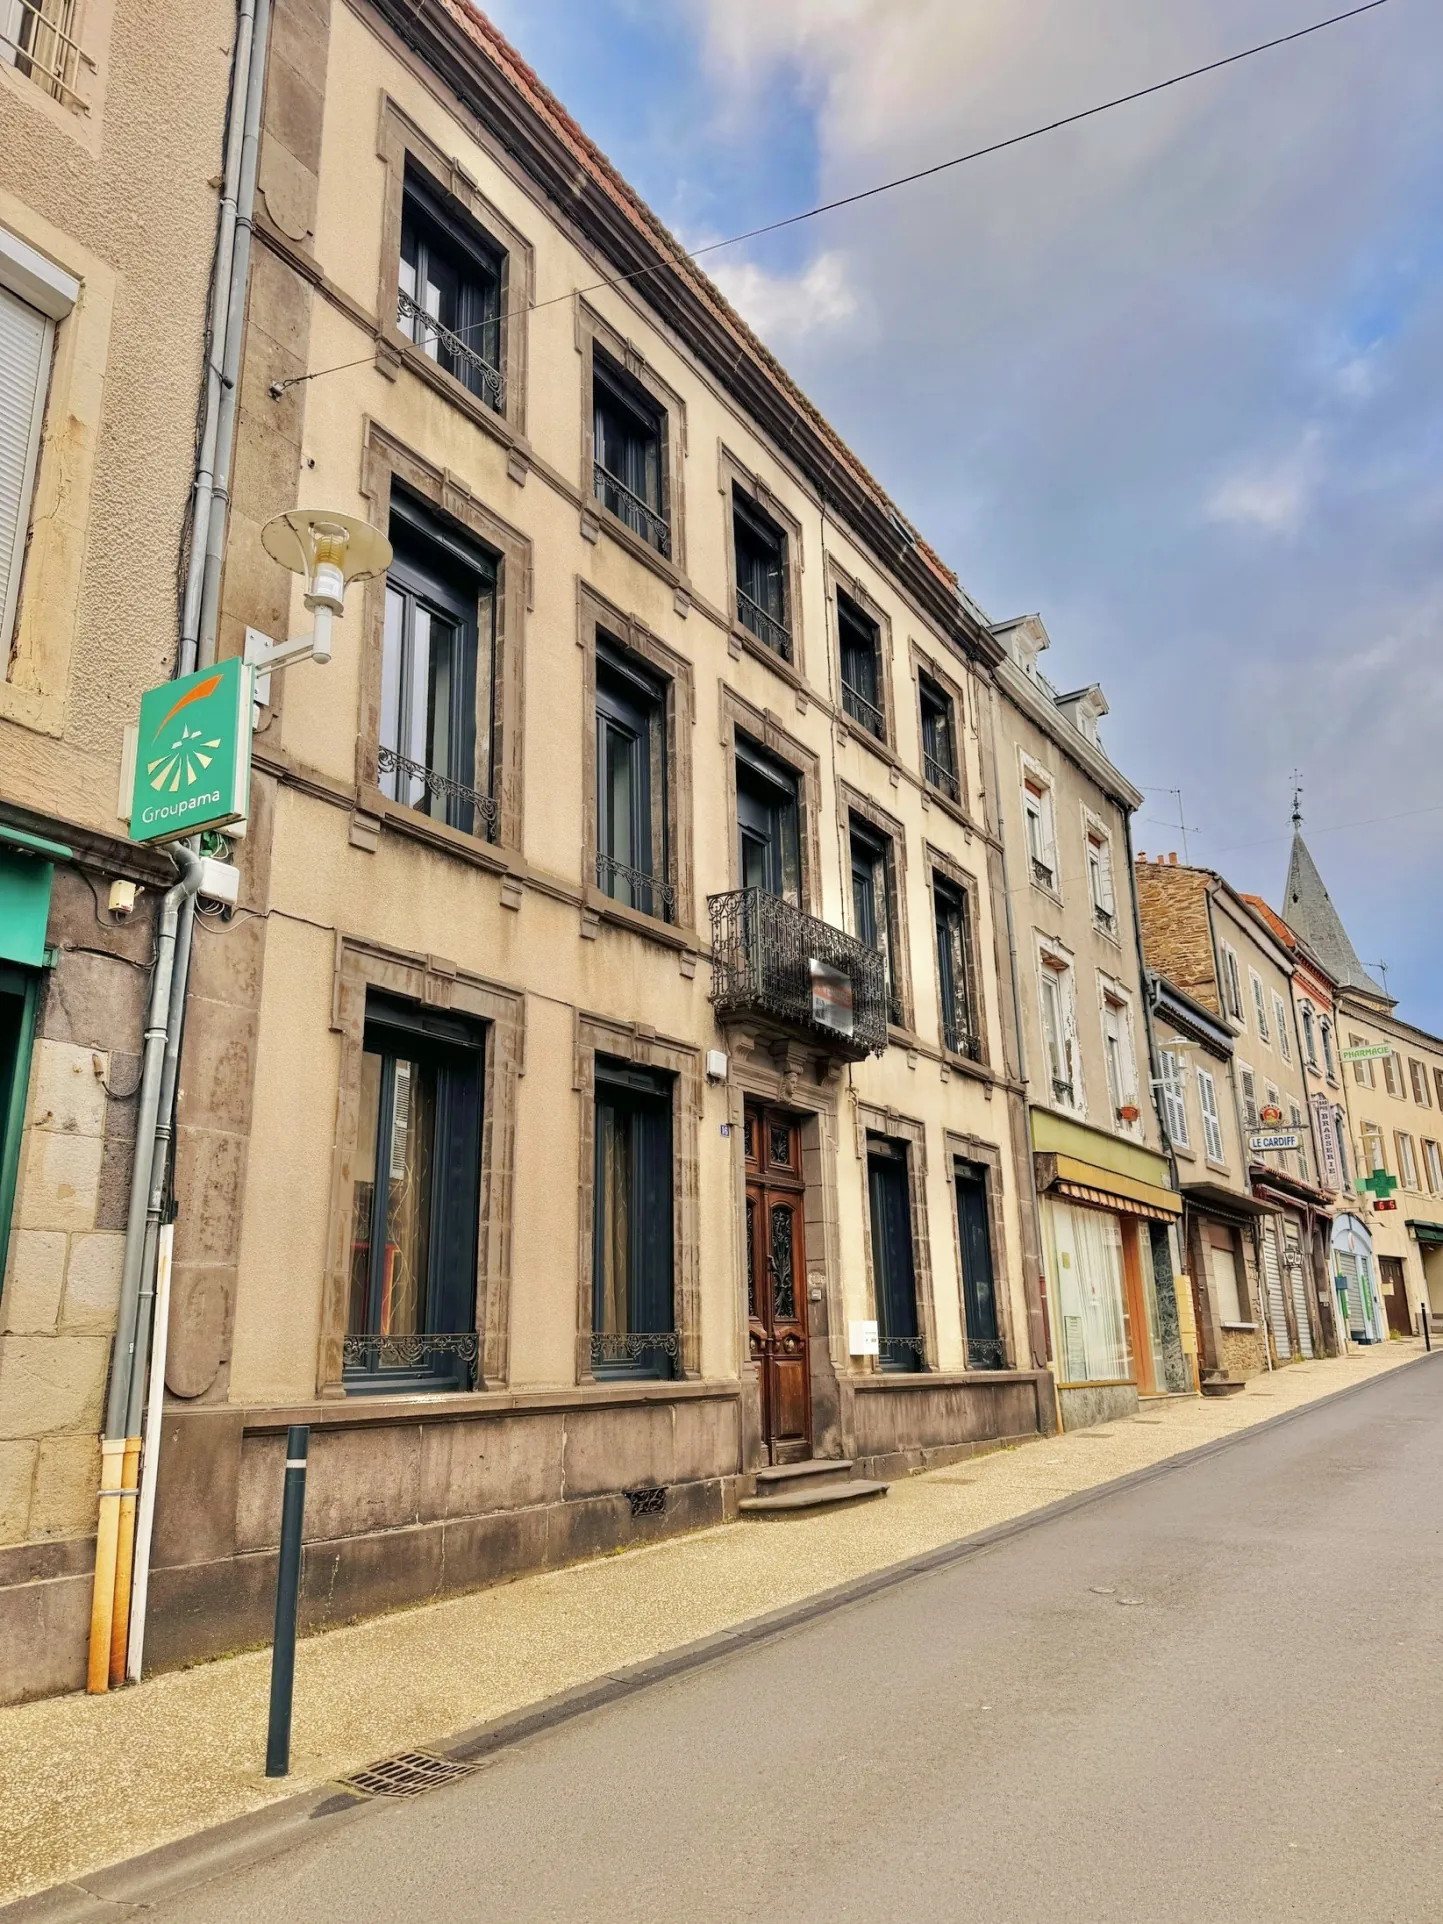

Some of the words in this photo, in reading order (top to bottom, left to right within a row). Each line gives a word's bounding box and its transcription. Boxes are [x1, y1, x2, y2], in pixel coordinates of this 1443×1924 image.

[142, 790, 220, 823] Groupama
[1343, 1046, 1389, 1058] PHARMACIE
[1252, 1138, 1261, 1147] LE
[1263, 1136, 1295, 1147] CARDIFF
[1321, 1113, 1336, 1174] BRASSERIE
